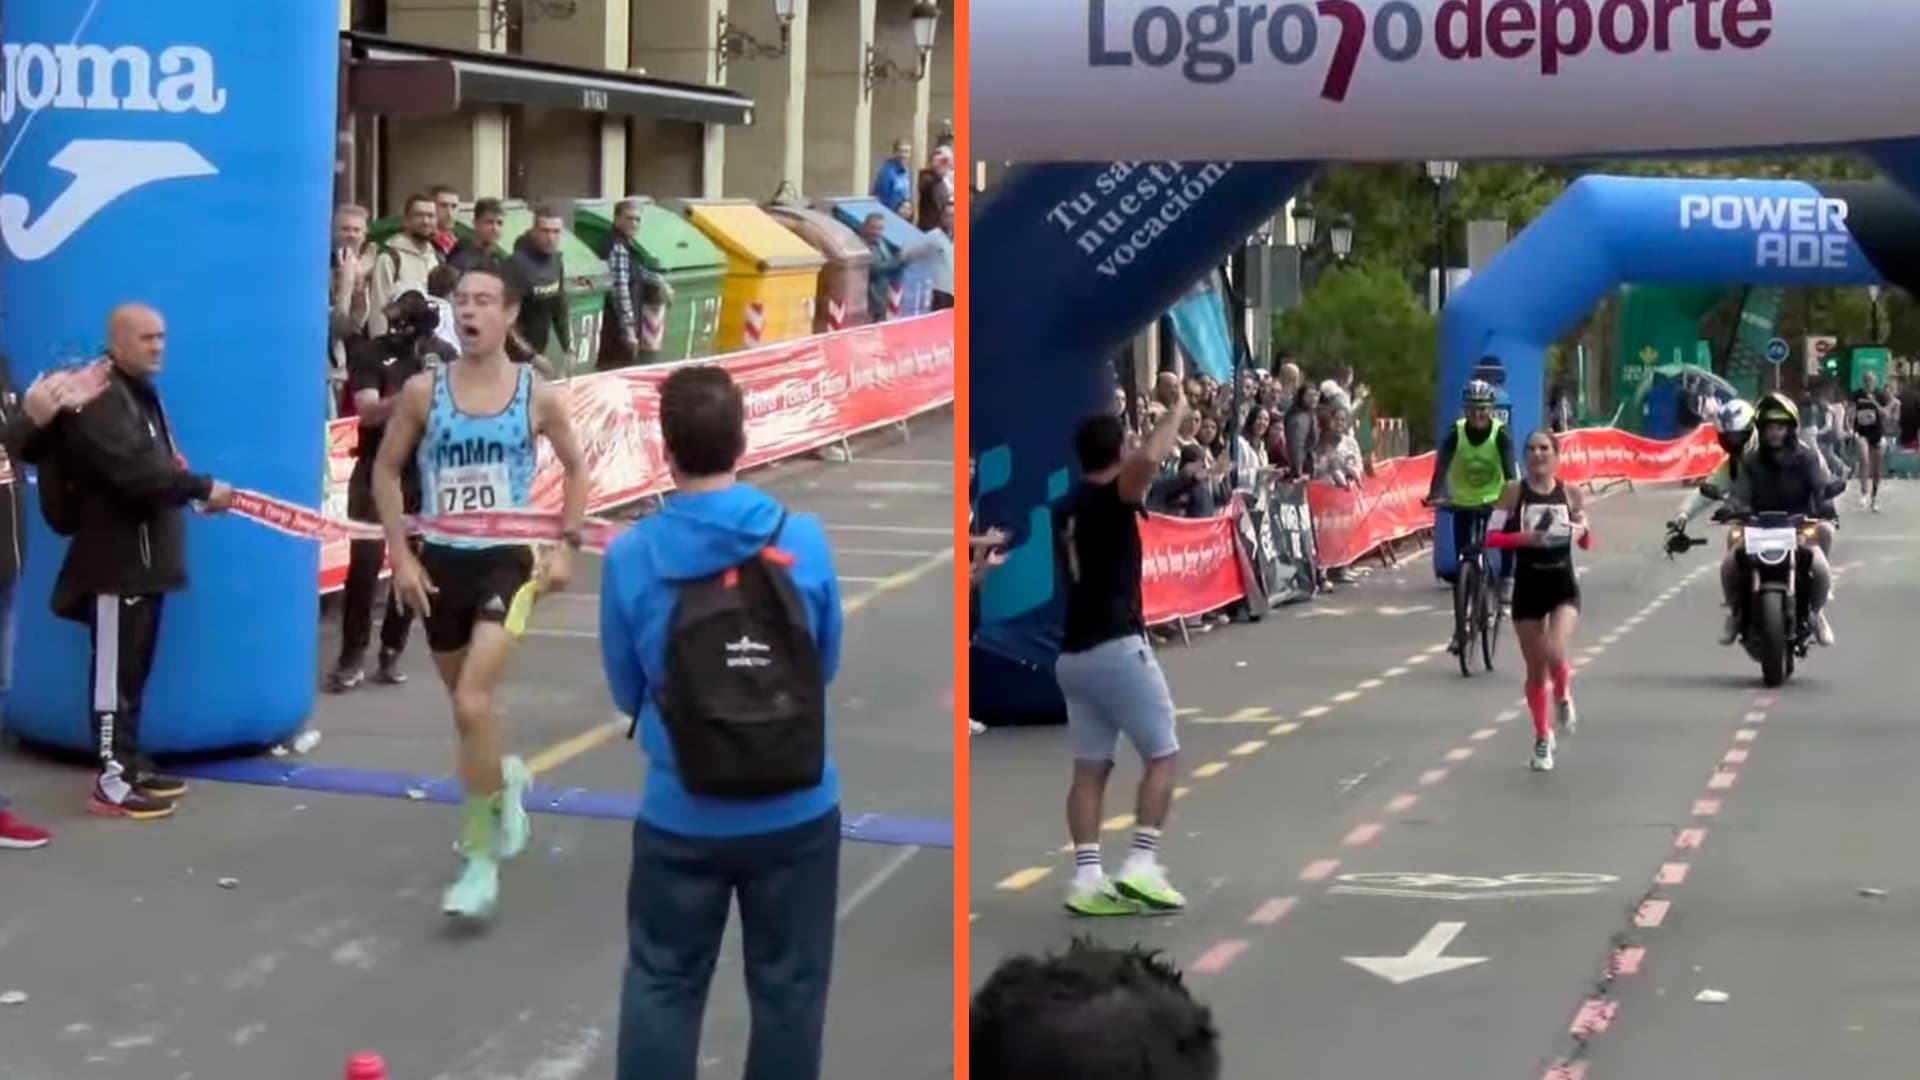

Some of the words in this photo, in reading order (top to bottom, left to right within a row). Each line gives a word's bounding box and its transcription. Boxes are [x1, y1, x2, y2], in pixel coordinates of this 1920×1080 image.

[1434, 0, 1773, 75] deporte
[1047, 191, 1097, 233] Tu
[1095, 160, 1141, 195] sa
[1096, 161, 1233, 277] vocación.
[1680, 195, 1849, 232] POWER
[1755, 232, 1848, 268] ADE
[443, 486, 495, 512] 720
